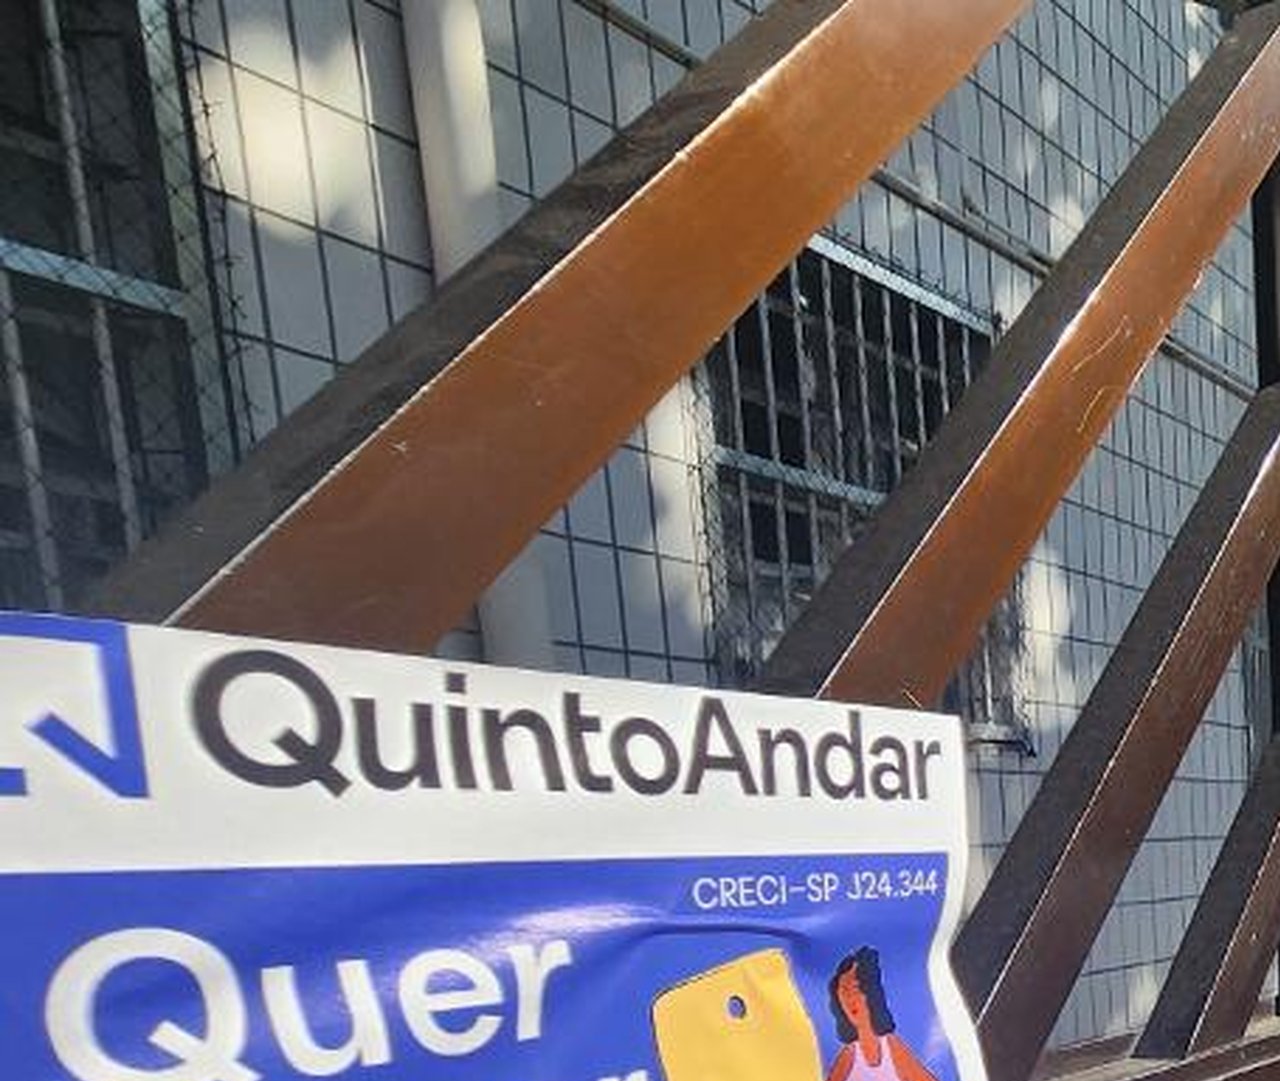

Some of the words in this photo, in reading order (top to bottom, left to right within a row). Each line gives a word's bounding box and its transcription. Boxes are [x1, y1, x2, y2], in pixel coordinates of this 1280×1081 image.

[192, 650, 941, 802] QuintoAndar
[692, 873, 838, 911] CRECI-SP
[846, 869, 939, 901] J24.344
